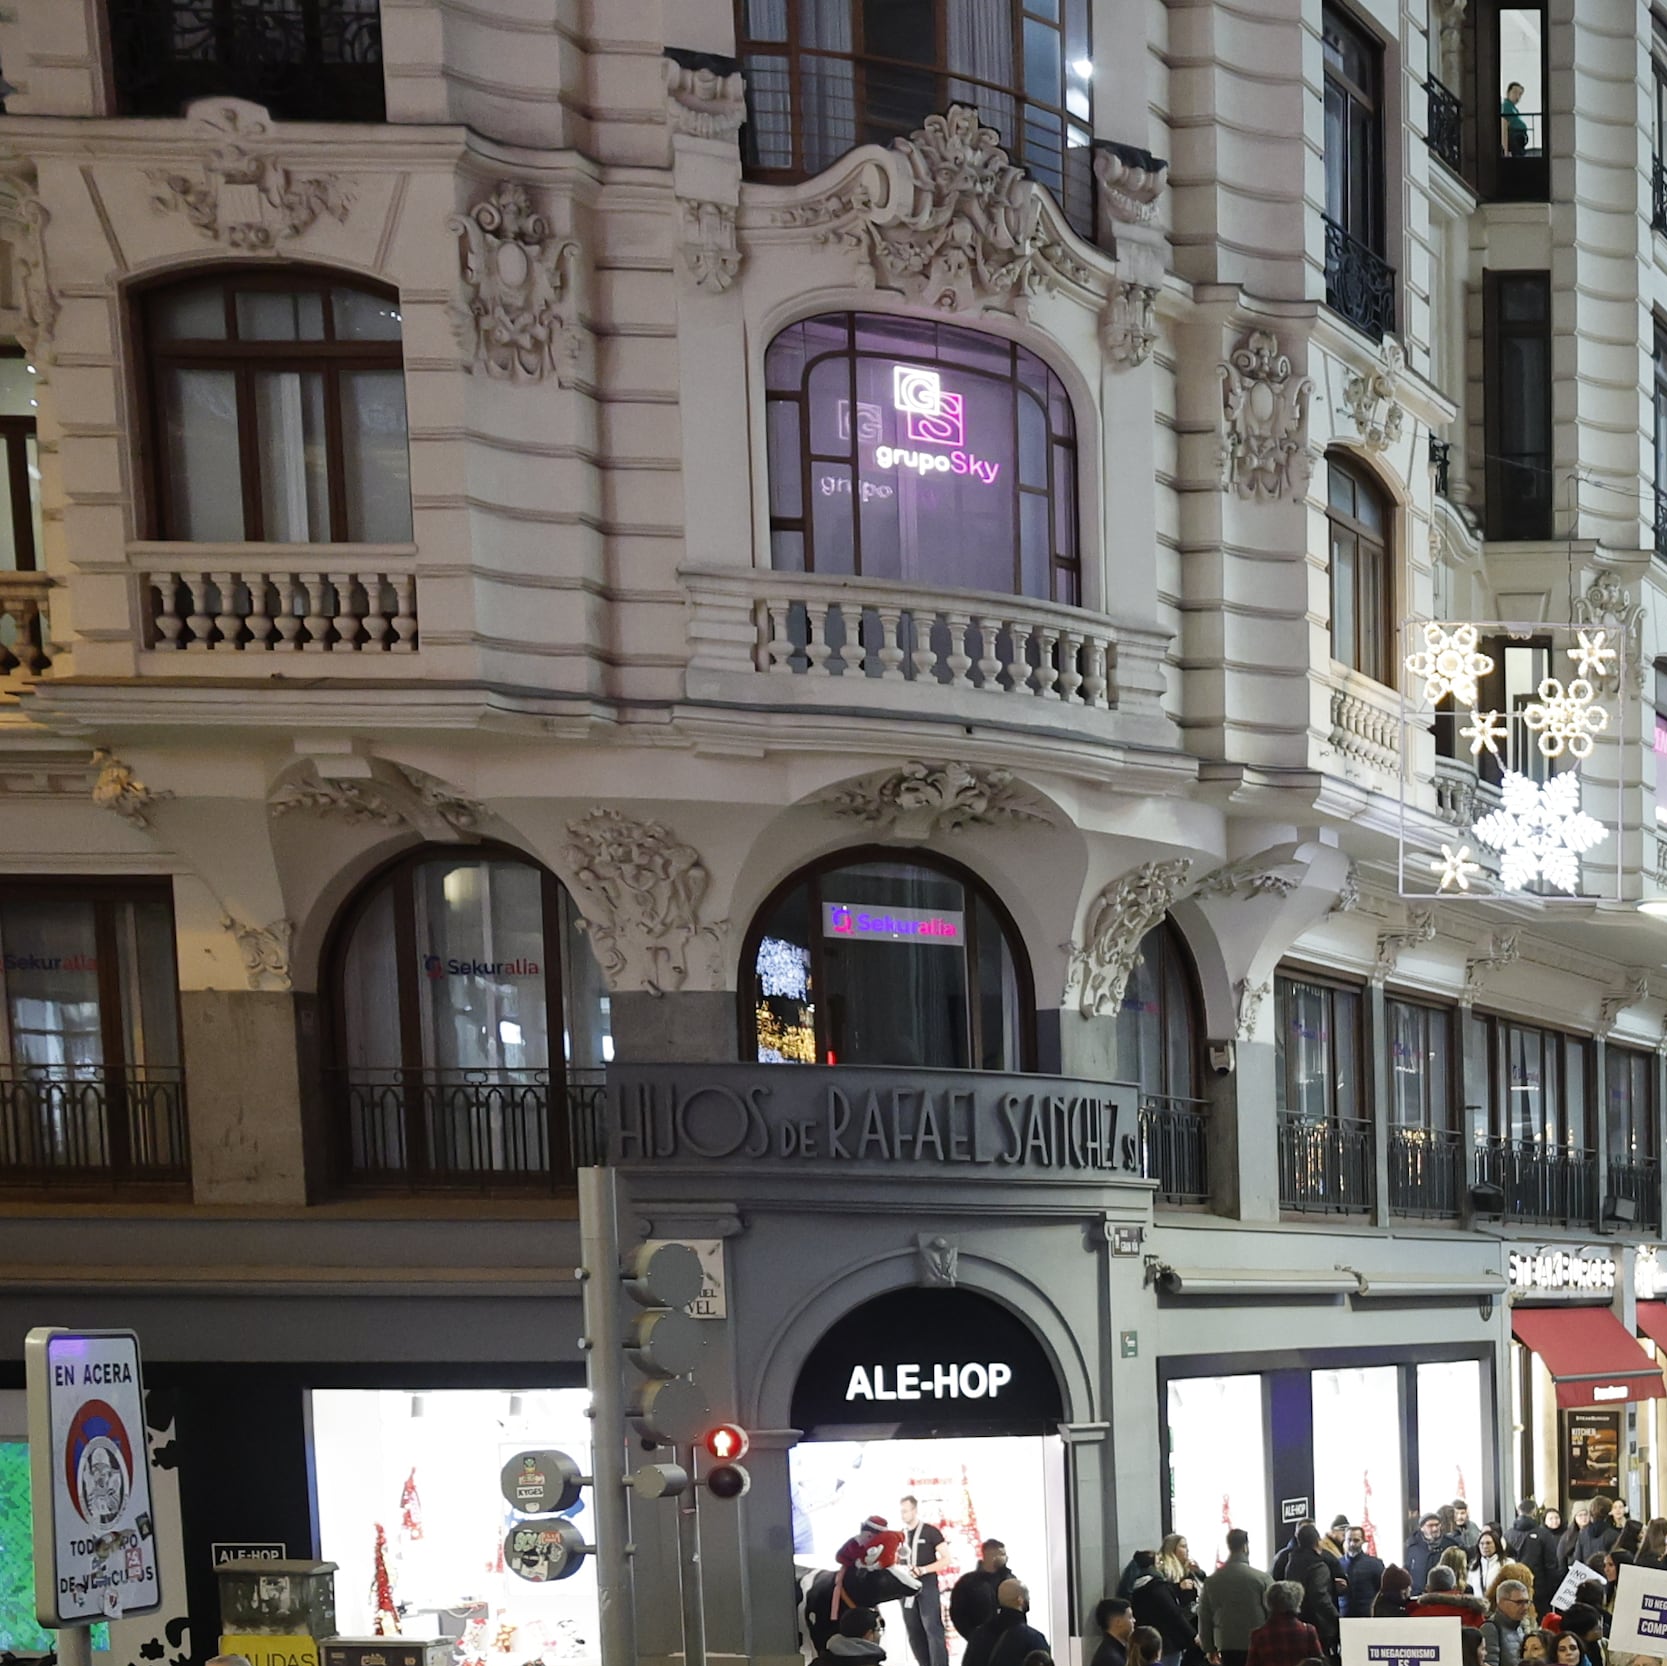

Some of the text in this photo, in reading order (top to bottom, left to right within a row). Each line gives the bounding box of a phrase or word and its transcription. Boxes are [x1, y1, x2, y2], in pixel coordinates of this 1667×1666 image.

[857, 913, 957, 937] Sekuralia
[447, 958, 539, 977] Sekuralia
[616, 1083, 770, 1159] HIJOS
[827, 1083, 992, 1164] RAFAEL
[54, 1362, 133, 1386] EN ACERA
[845, 1362, 1013, 1401] ALE-HOP
[1644, 1597, 1653, 1608] TU
[1370, 1648, 1436, 1659] TU NEGACIONISMO
